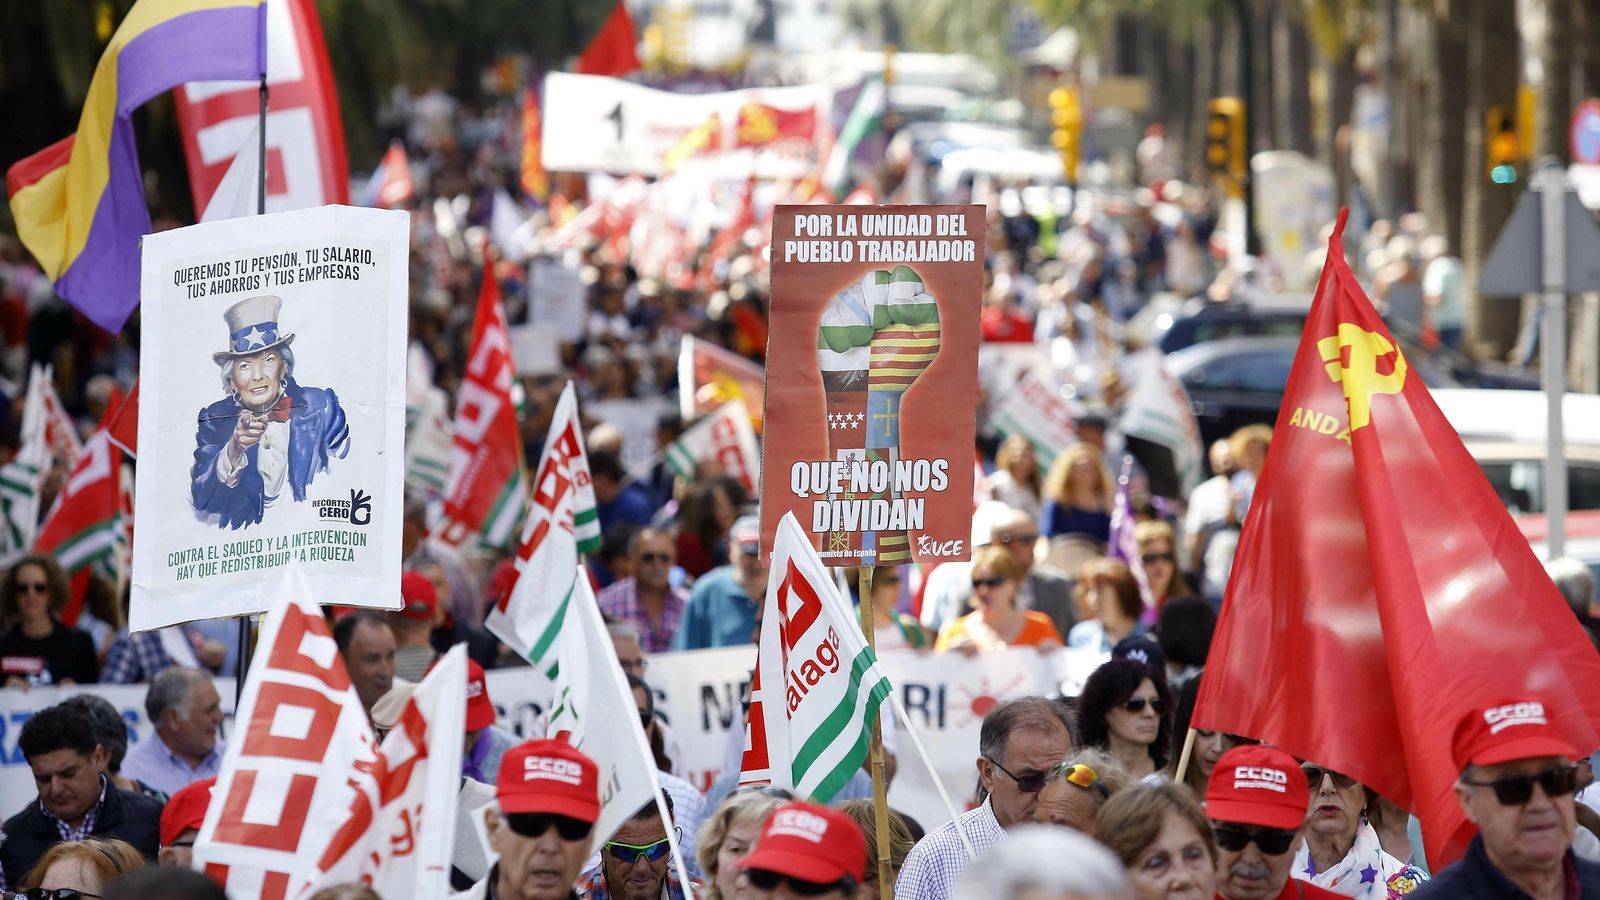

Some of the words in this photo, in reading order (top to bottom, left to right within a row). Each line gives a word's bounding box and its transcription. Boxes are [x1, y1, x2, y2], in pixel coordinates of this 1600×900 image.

[794, 214, 833, 237] POR
[836, 214, 858, 237] LA
[861, 214, 933, 237] UNIDAD
[936, 214, 968, 237] DEL
[174, 261, 231, 286] QUEREMOS
[234, 259, 248, 275] TU
[251, 250, 301, 272] PENSIÓN,
[305, 248, 319, 264] TU
[322, 246, 376, 267] SALARIO,
[784, 240, 854, 263] PUEBLO
[857, 239, 976, 262] TRABAJADOR
[187, 282, 206, 299] TUS
[209, 275, 260, 296] AHORROS
[265, 272, 270, 288] Y
[274, 269, 295, 286] TUS
[299, 263, 360, 283] EMPRESAS
[790, 461, 844, 498] QUE
[850, 460, 888, 493] NO
[895, 458, 949, 492] NOS
[312, 499, 351, 508] RECORTES
[319, 507, 349, 518] CERO
[812, 498, 925, 533] DIVIDAN
[168, 546, 204, 567] CONTRA
[207, 545, 220, 560] EL
[223, 538, 263, 558] SAQUEO
[266, 537, 274, 552] Y
[276, 535, 289, 550] LA
[292, 529, 367, 548] INTERVENCIÓN
[176, 564, 195, 581] HAY
[198, 561, 217, 579] QUE
[221, 550, 291, 573] REDISTRIBUIR
[309, 545, 355, 563] RIQUEZA
[853, 549, 877, 557] España
